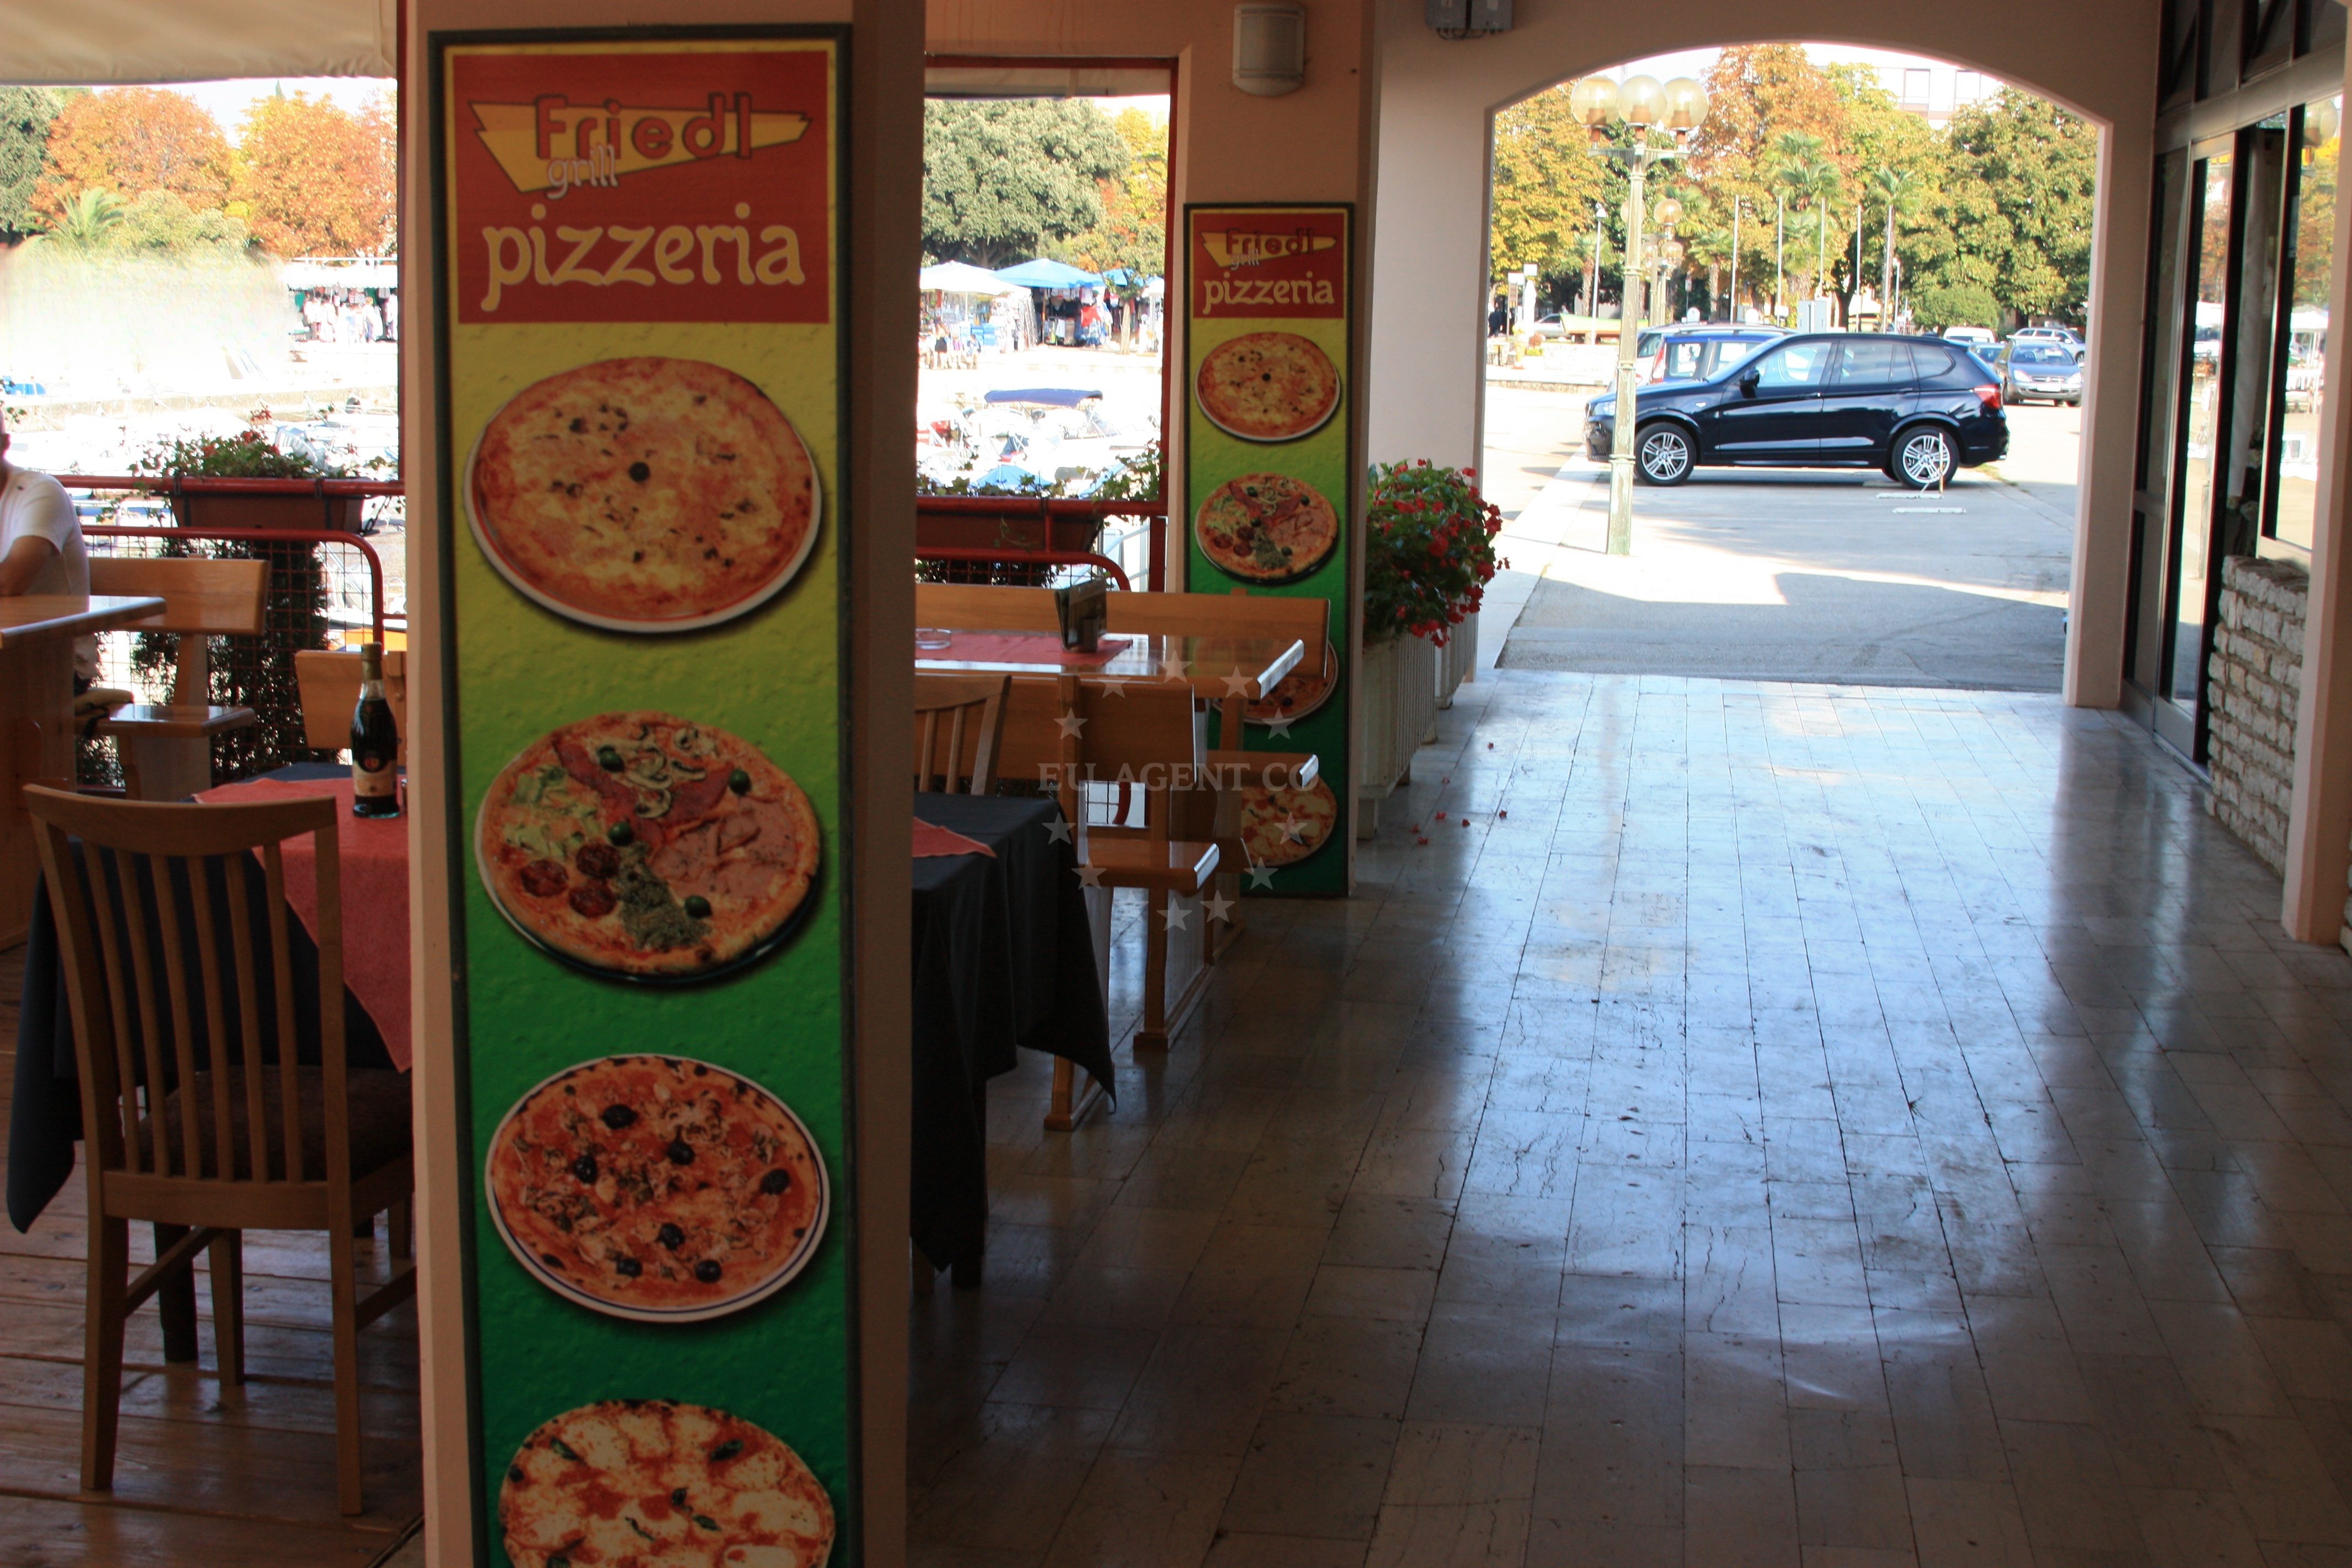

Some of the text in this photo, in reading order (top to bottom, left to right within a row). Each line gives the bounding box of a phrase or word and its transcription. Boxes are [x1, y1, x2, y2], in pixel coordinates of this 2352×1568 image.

[535, 92, 752, 160] Friedl
[546, 142, 619, 200] grill
[481, 202, 805, 312] pizzeria
[1226, 228, 1314, 254] Friedl
[1229, 248, 1260, 271] grill
[1202, 270, 1335, 315] pizzeria
